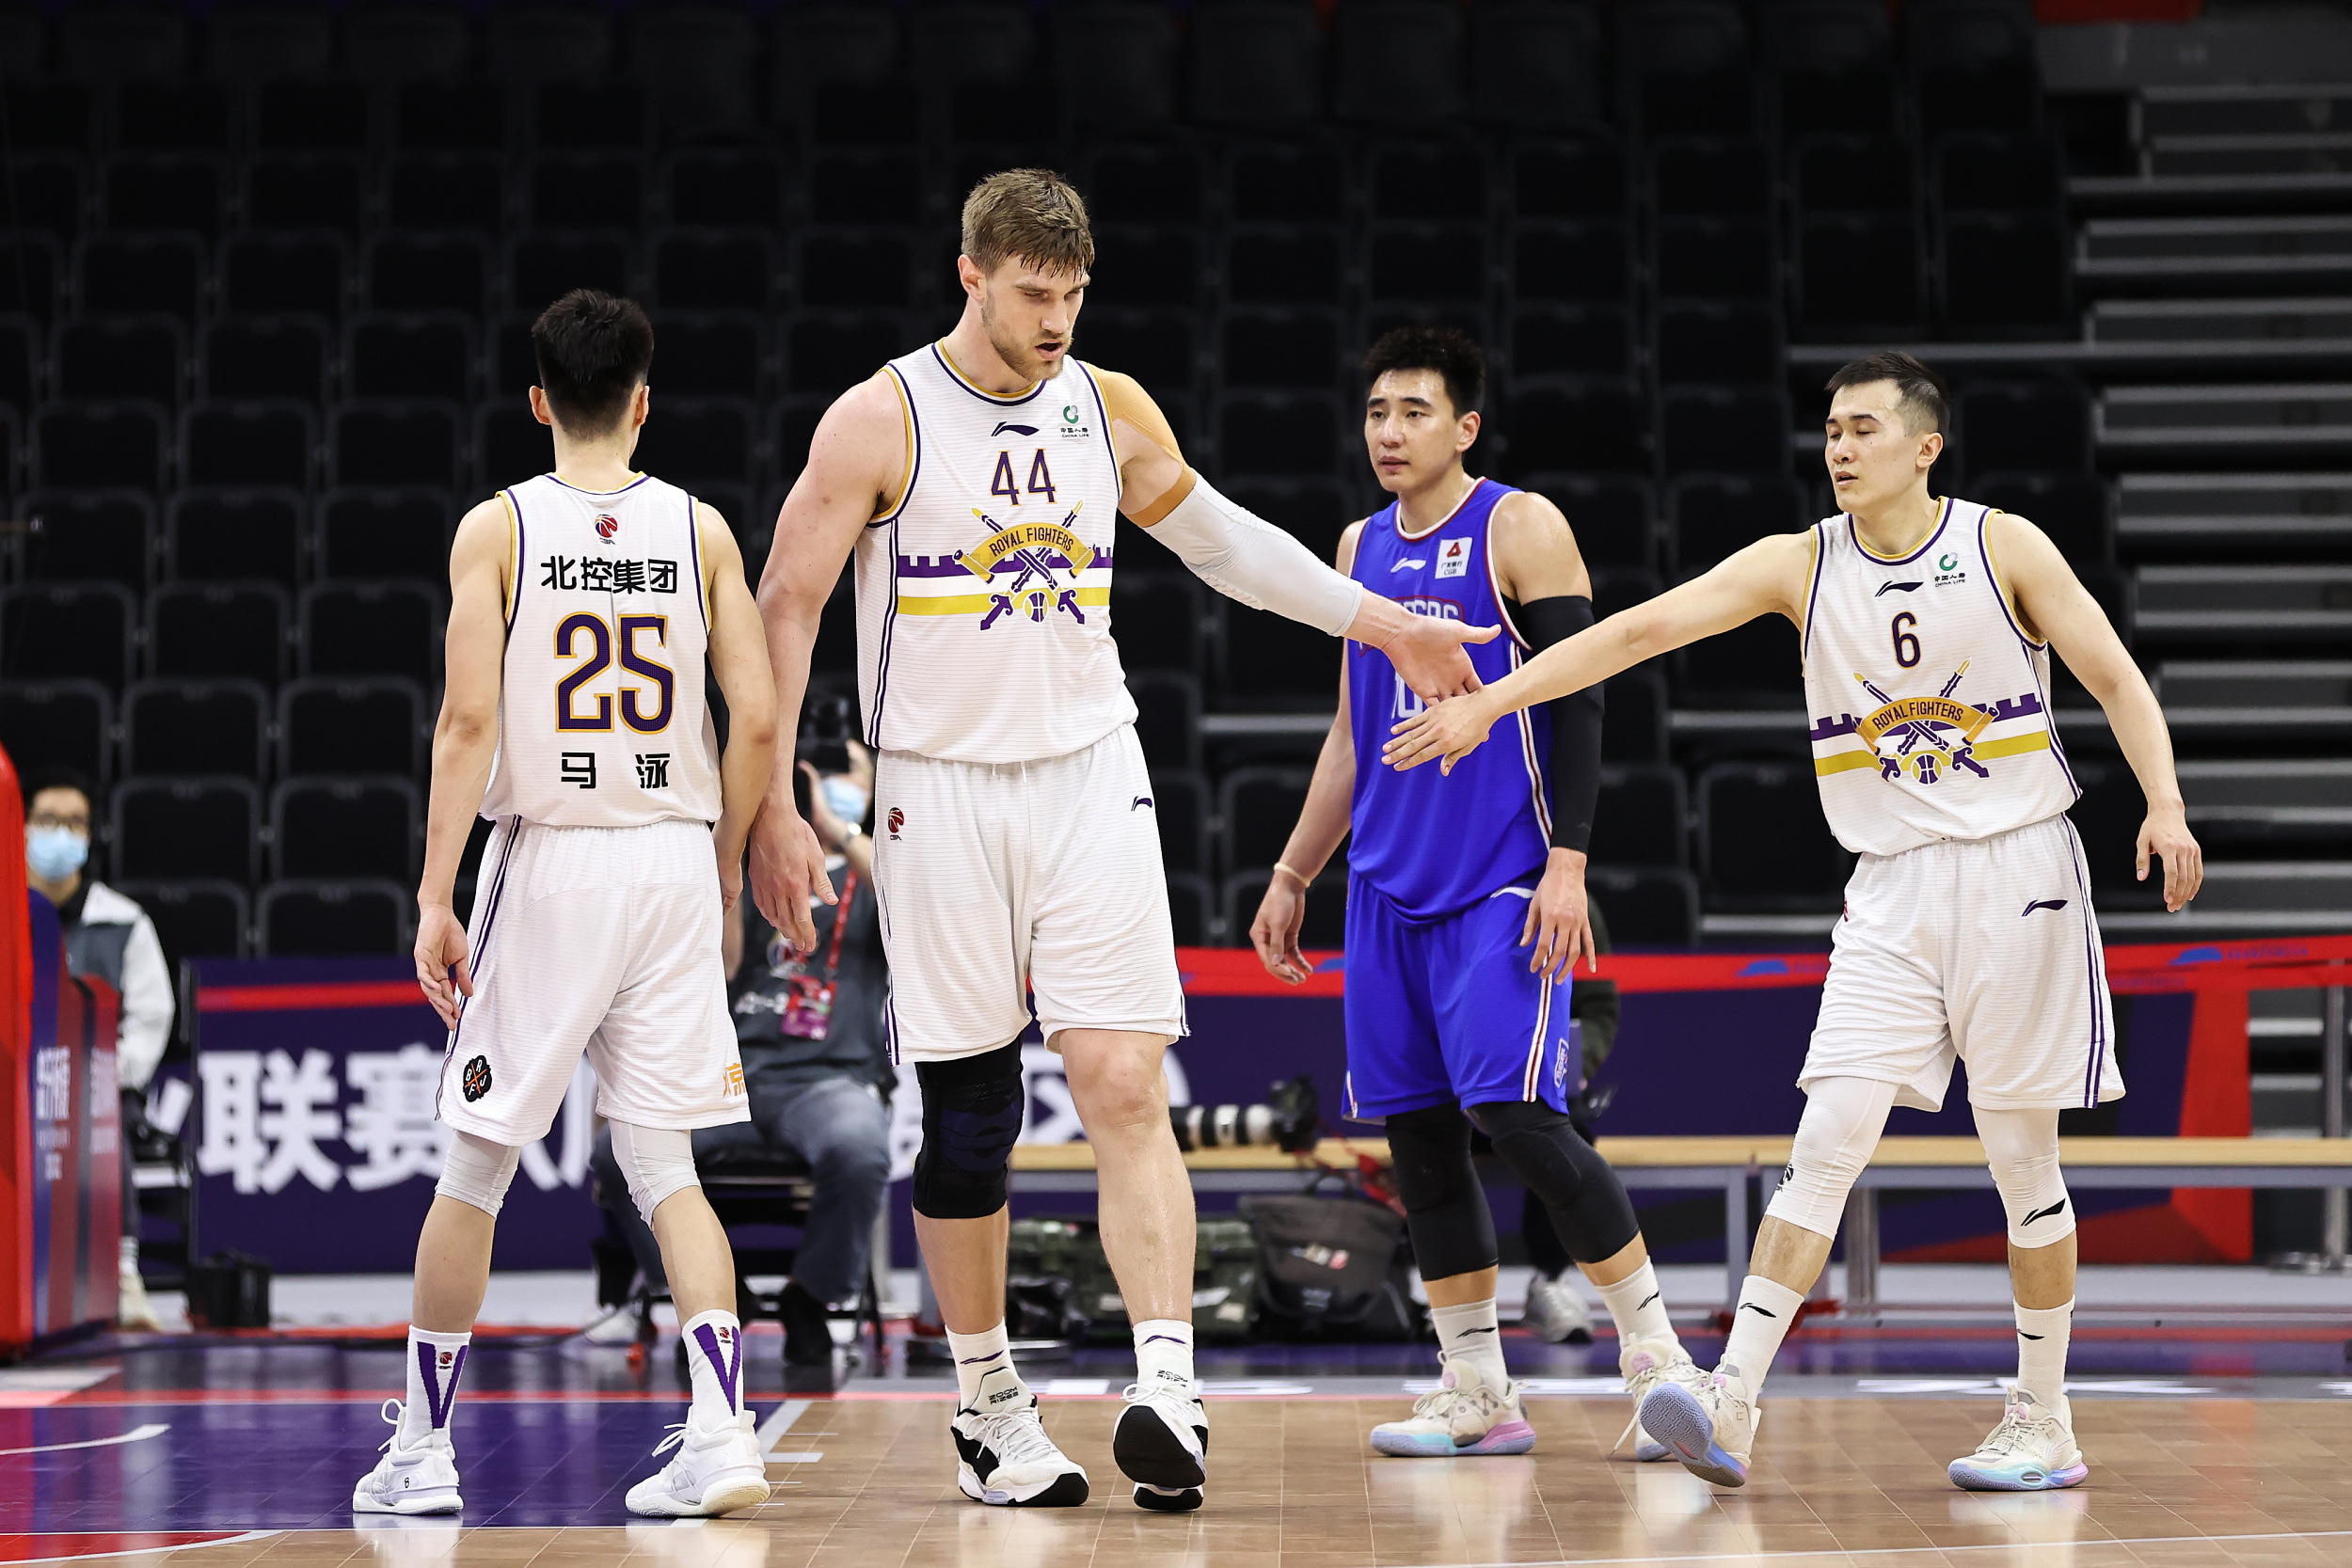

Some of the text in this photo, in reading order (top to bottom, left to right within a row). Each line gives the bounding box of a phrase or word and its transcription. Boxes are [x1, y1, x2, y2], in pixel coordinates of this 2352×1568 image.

[991, 448, 1057, 507] 44
[989, 527, 1074, 557] ROYAL FIGHTERS
[540, 555, 678, 595] 北控集团
[1891, 611, 1922, 671] 6
[554, 611, 675, 736] 25
[1871, 701, 1964, 731] ROYAL FIGHTERS
[561, 752, 671, 789] 马 泳
